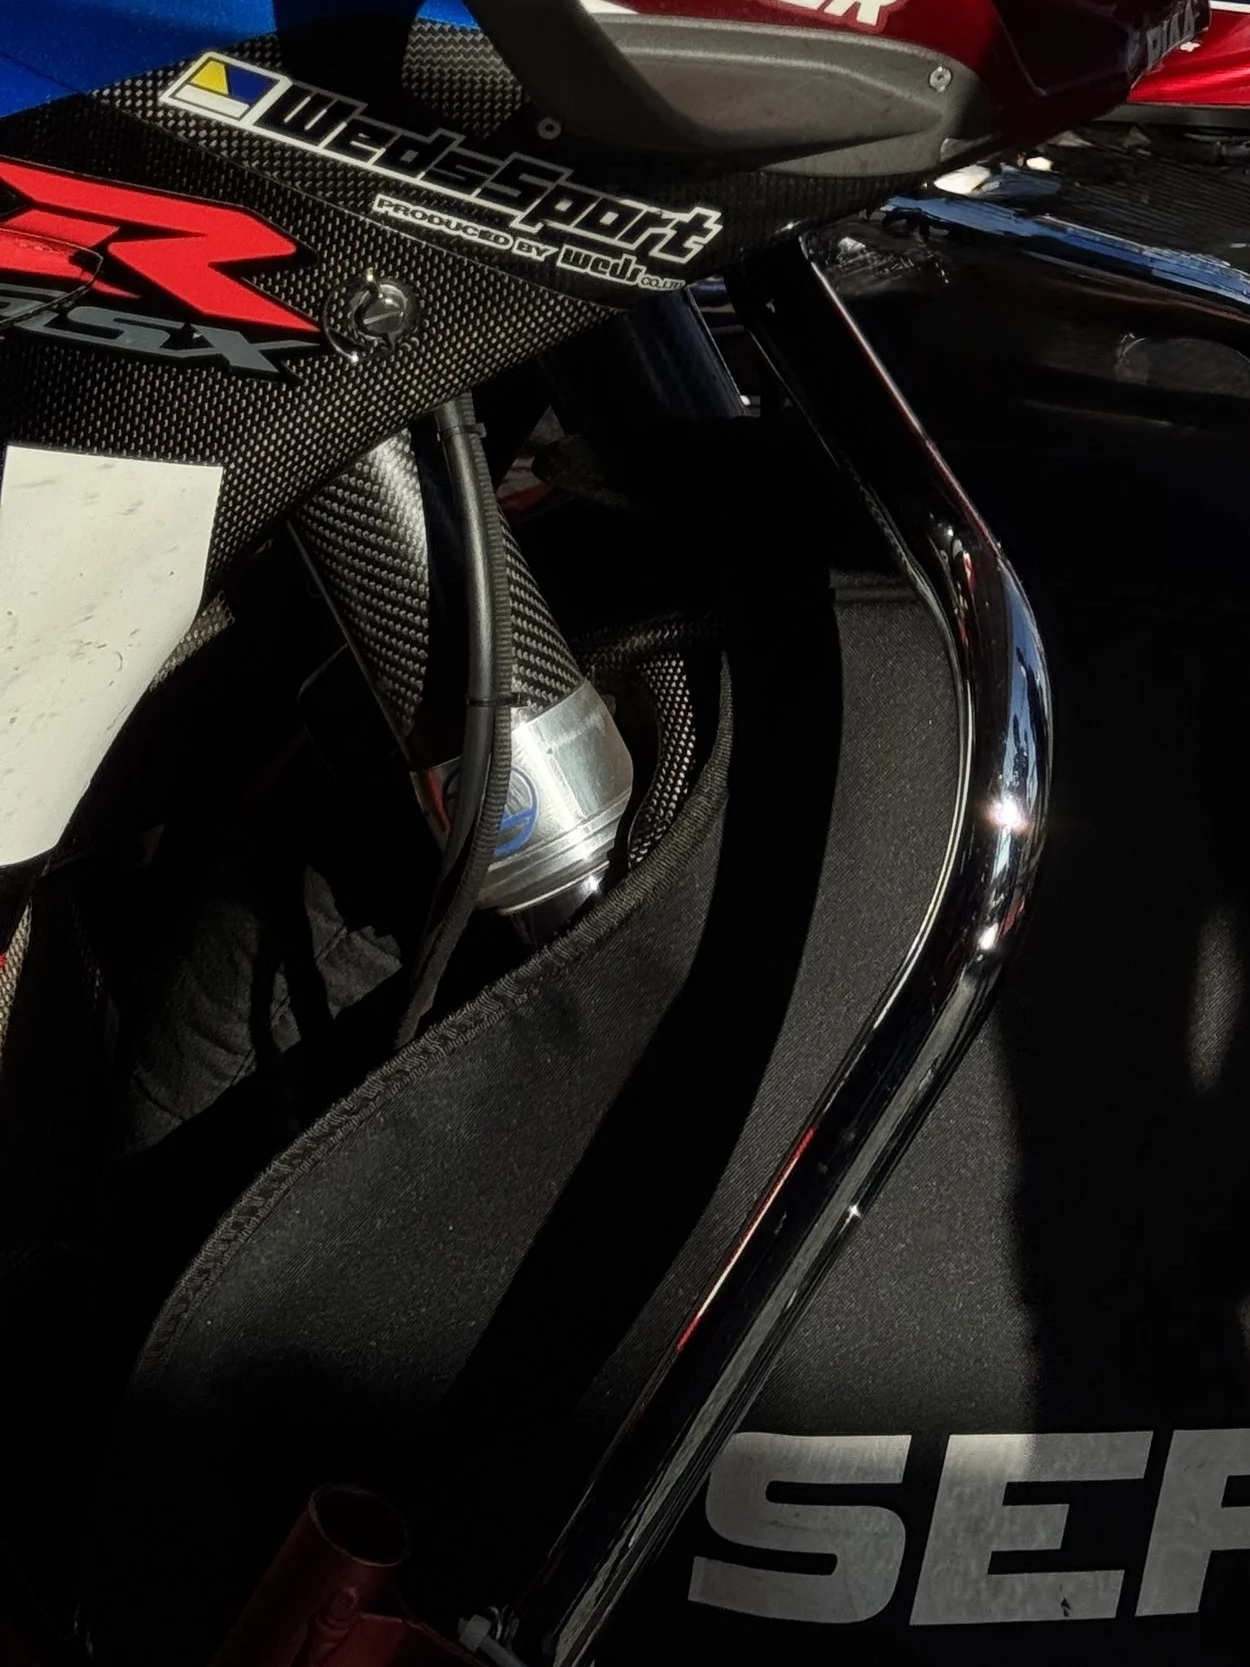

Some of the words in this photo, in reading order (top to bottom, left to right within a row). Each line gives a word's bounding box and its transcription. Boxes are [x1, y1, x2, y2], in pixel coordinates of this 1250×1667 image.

[258, 80, 725, 263] WedsSport
[373, 196, 514, 249] PRODUCED
[514, 238, 556, 261] BY
